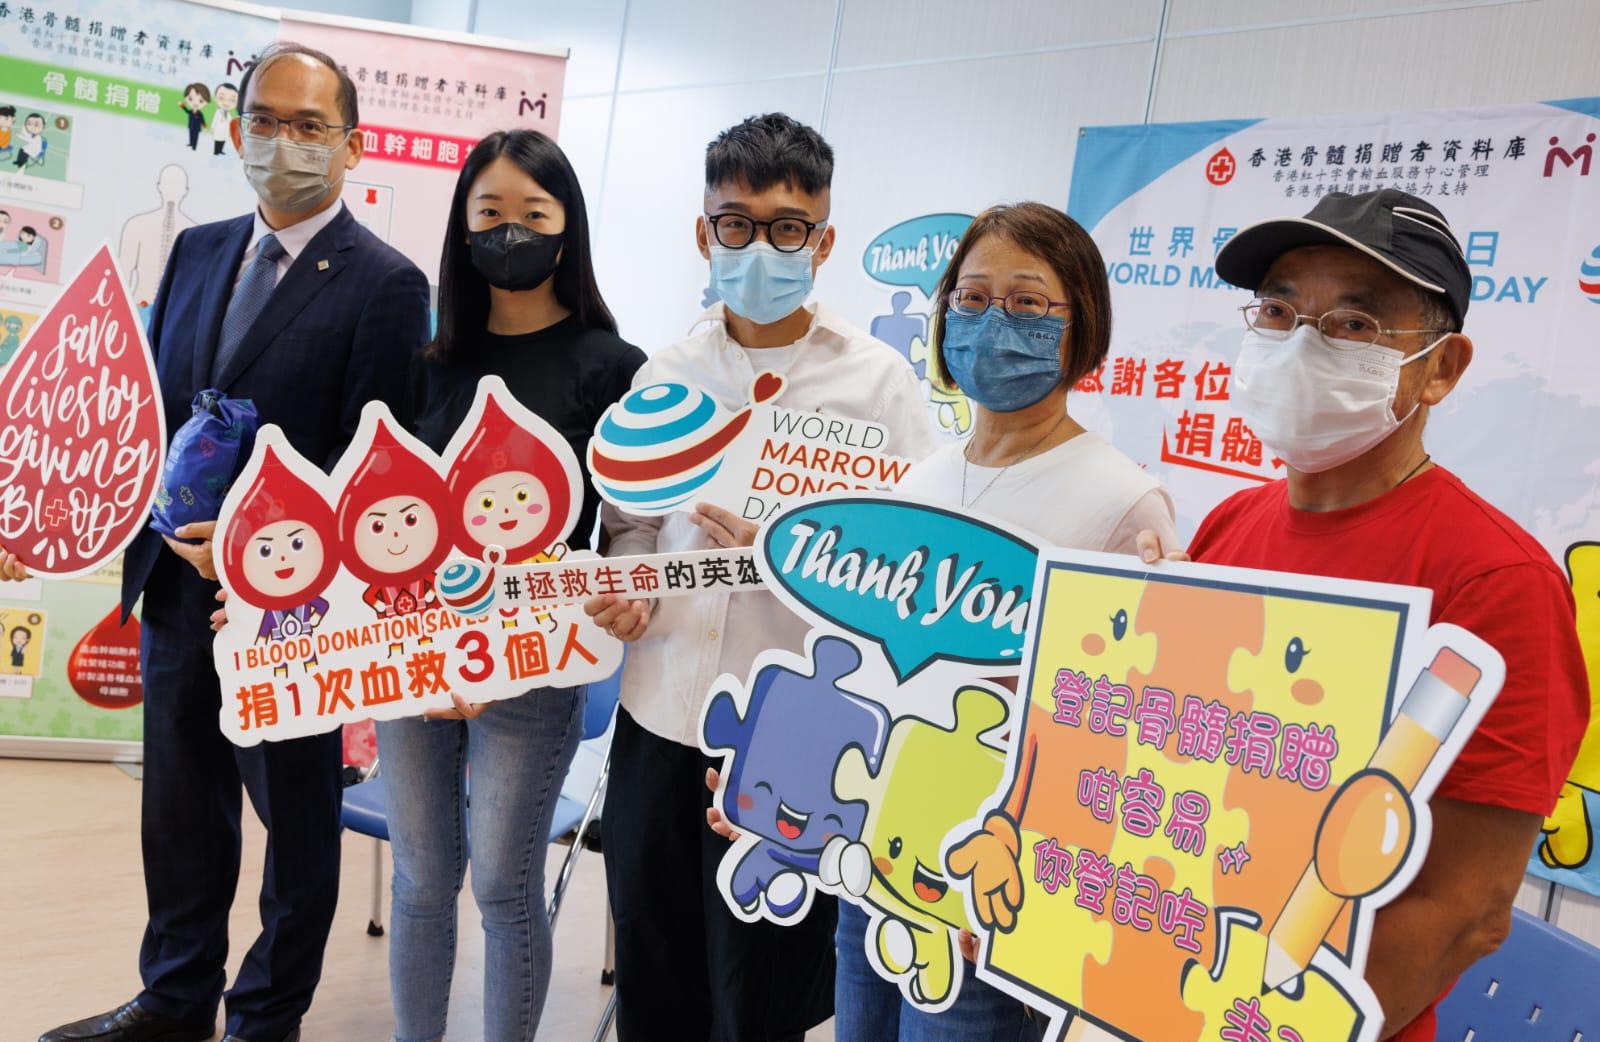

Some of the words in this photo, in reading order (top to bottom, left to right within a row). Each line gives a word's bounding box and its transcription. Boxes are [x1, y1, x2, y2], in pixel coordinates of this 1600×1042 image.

[43, 71, 161, 115] 骨髓捐贈
[1247, 136, 1527, 168] 香港骨髓捐贈者資料庫
[870, 233, 930, 274] Thank
[930, 230, 962, 271] Yo
[1466, 231, 1499, 267] 日
[1470, 275, 1549, 303] DAY
[773, 411, 885, 449] WORLD
[751, 466, 870, 497] DON
[760, 438, 912, 485] MARROW
[782, 518, 930, 620] Thank
[920, 552, 1030, 635] You
[245, 639, 313, 669] BLOOD
[316, 617, 421, 656] DONATION
[236, 623, 599, 731] 捐1次血救3個人
[1052, 668, 1339, 791] 登記骨髓捐贈
[1078, 767, 1211, 856] 咁容易
[1033, 837, 1208, 953] 你登記咗
